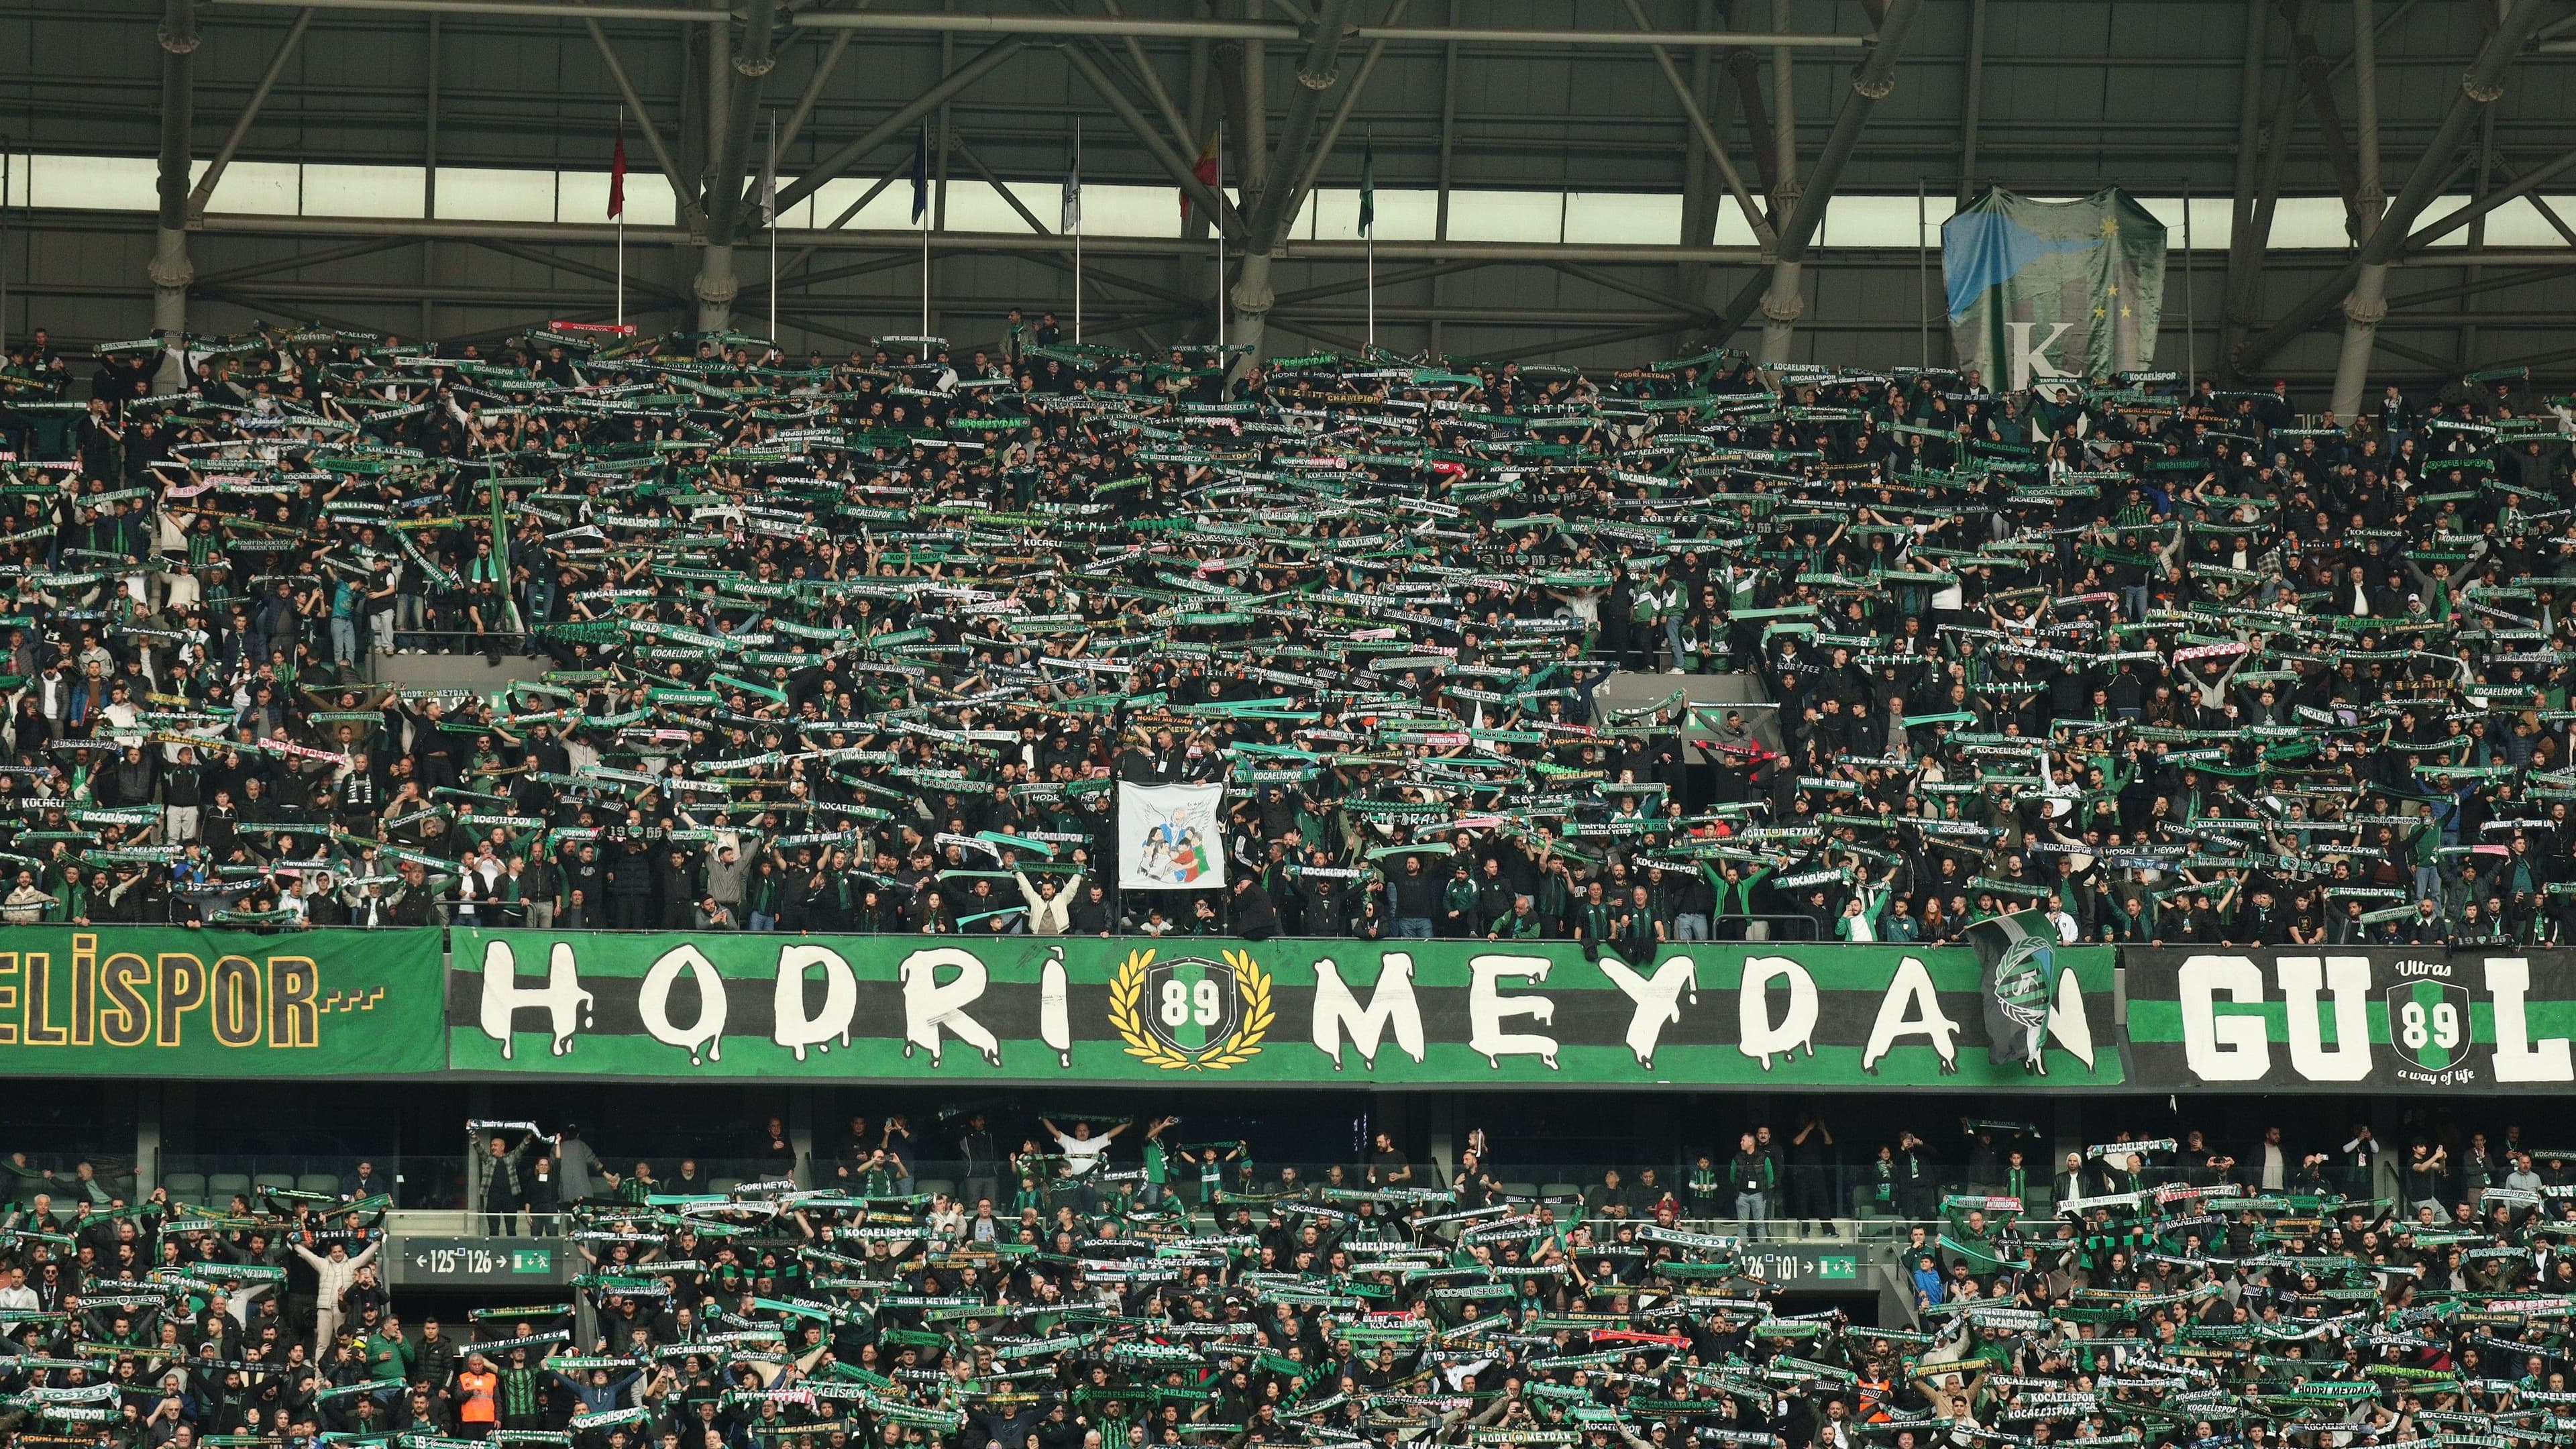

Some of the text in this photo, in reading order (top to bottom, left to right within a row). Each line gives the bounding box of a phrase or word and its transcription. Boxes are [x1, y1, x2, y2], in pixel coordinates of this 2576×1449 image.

[2395, 959, 2452, 977] Ultras
[1161, 979, 1221, 1027] 89
[2402, 1001, 2460, 1049] 89
[2397, 1068, 2475, 1086] a way of life
[431, 1249, 492, 1273] 125 126
[1776, 1256, 1797, 1279] 101
